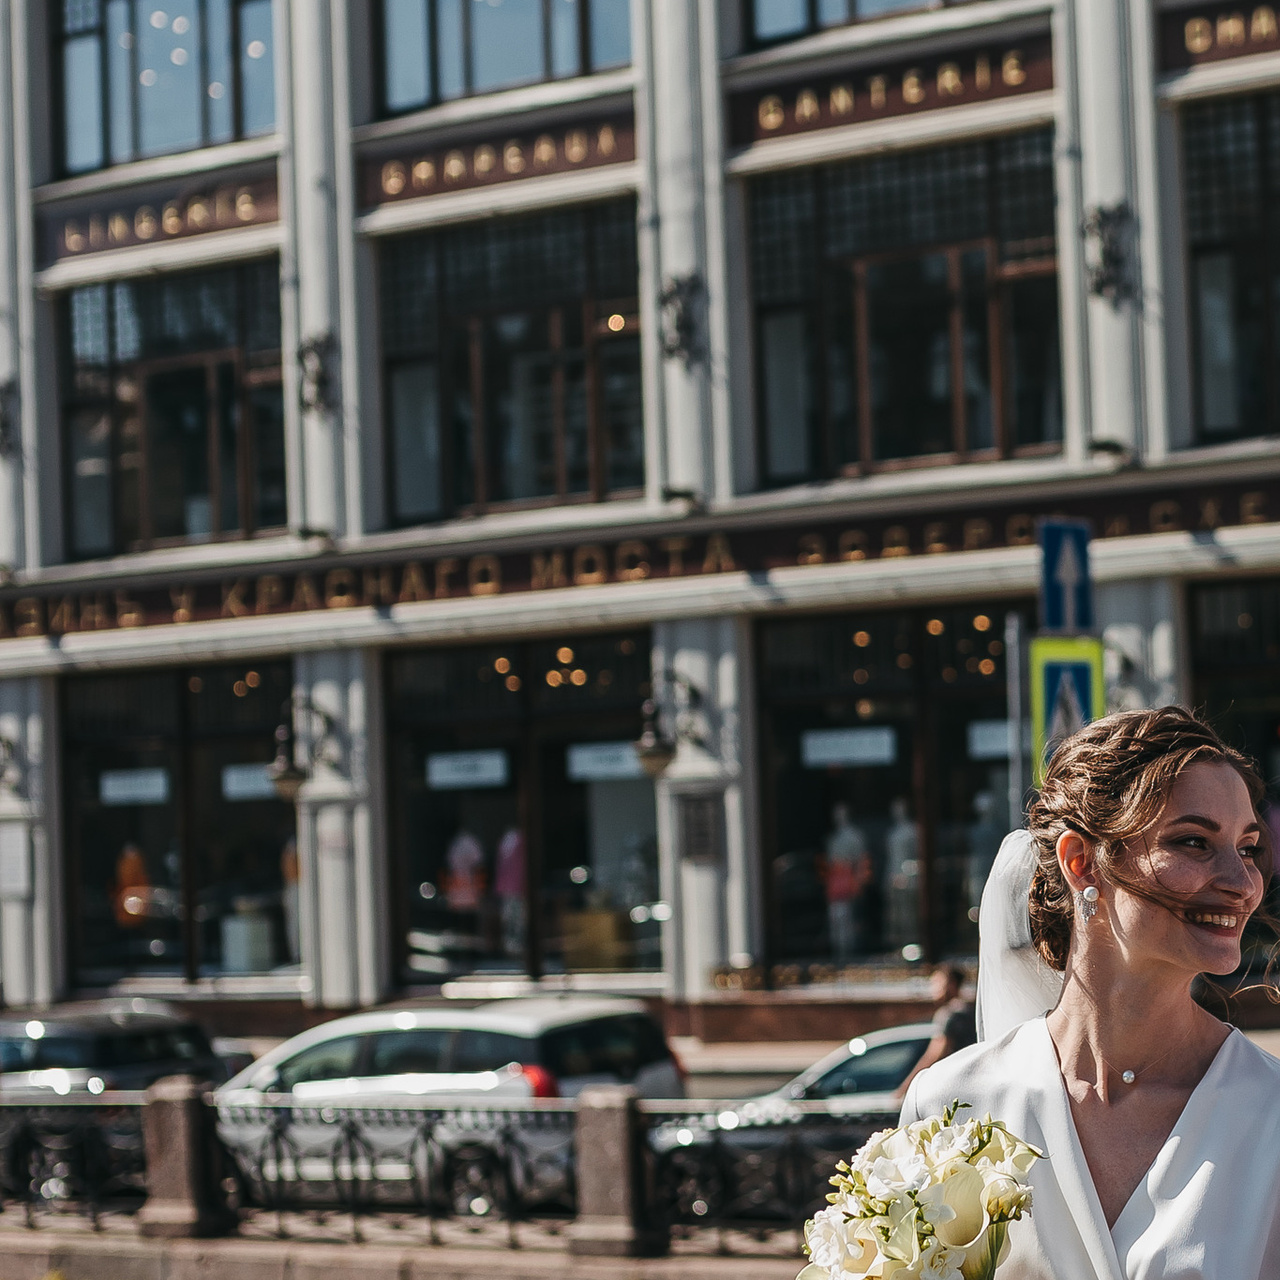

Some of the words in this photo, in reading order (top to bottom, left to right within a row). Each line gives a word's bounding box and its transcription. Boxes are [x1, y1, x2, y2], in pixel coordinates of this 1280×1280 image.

[757, 48, 1028, 131] GANTERIE
[221, 553, 502, 618] КРАСНАГО
[531, 533, 735, 589] МОСТА
